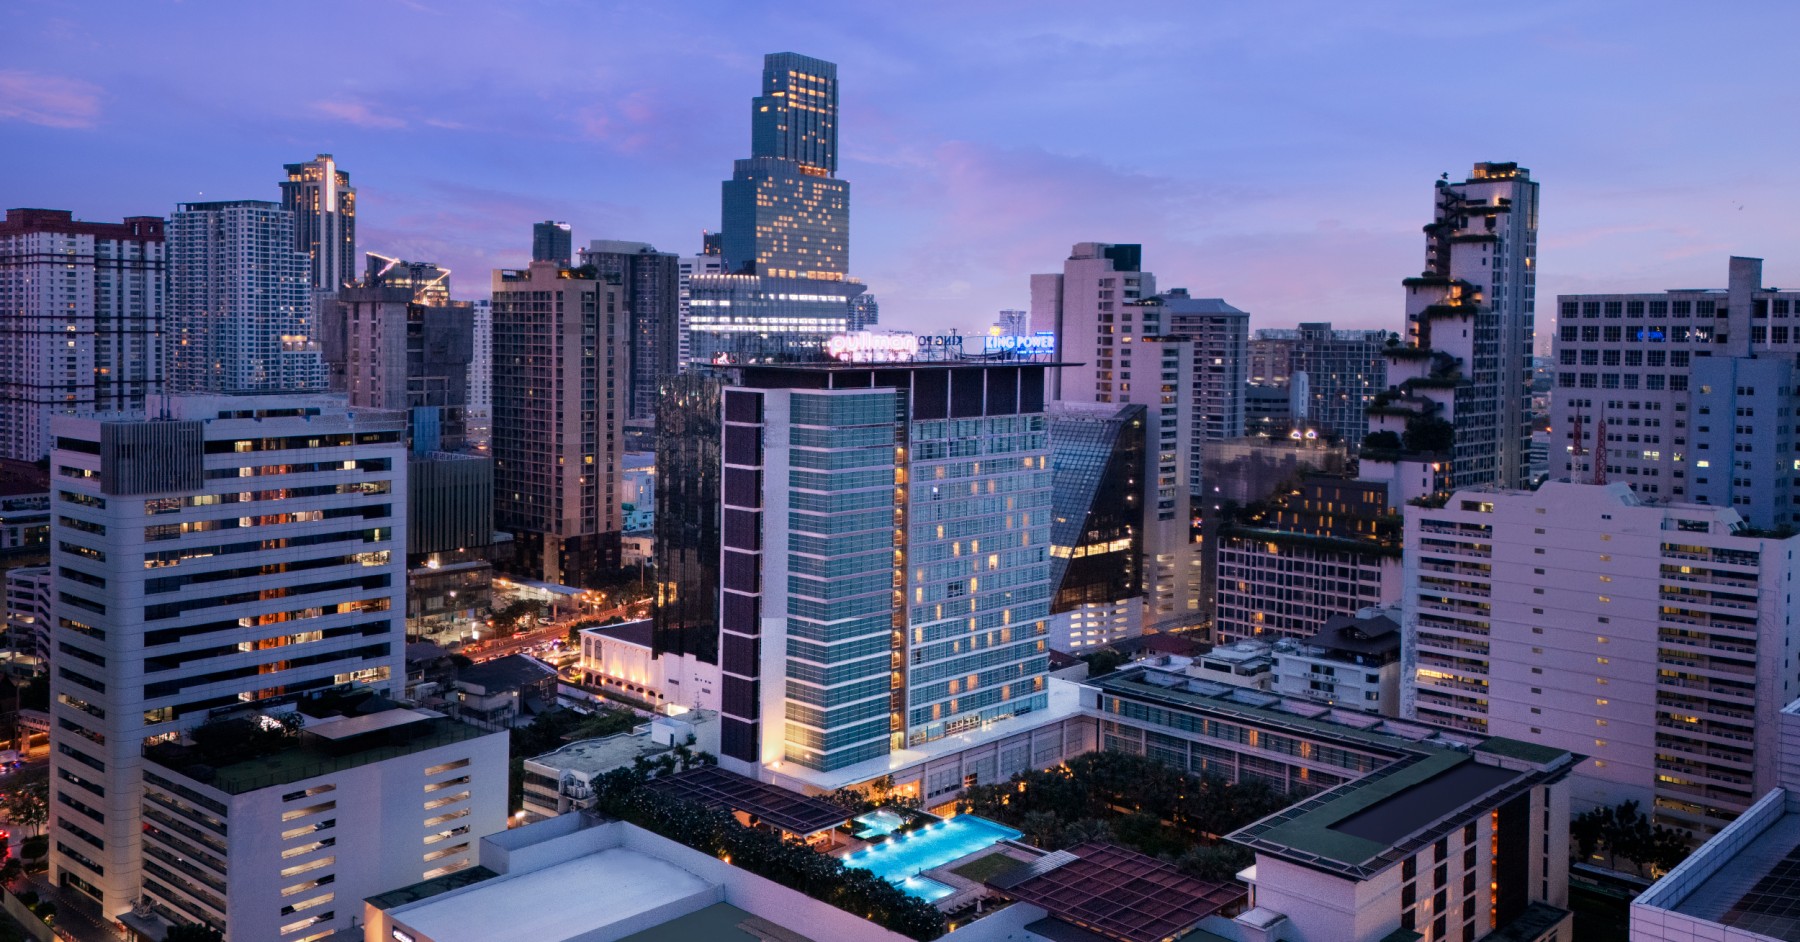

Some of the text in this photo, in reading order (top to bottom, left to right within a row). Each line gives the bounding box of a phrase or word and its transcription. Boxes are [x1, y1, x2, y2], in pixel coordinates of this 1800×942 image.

[831, 331, 915, 356] pullman
[985, 336, 1054, 348] KING POWER
